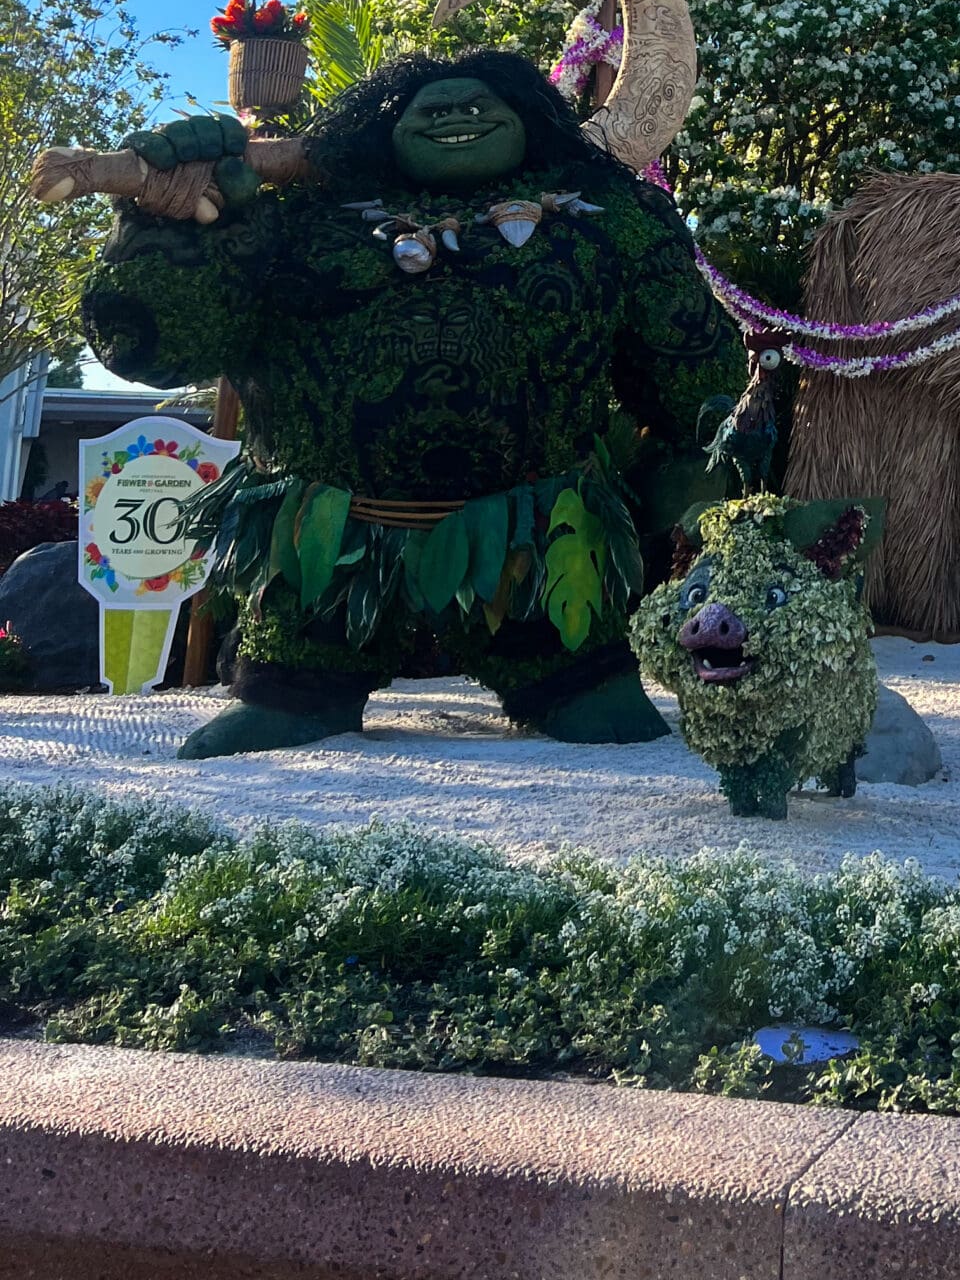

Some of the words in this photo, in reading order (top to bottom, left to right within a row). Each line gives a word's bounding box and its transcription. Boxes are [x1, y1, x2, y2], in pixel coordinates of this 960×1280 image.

[117, 479, 146, 487] FLOWER
[154, 479, 191, 487] GARDEN
[109, 497, 189, 545] 30
